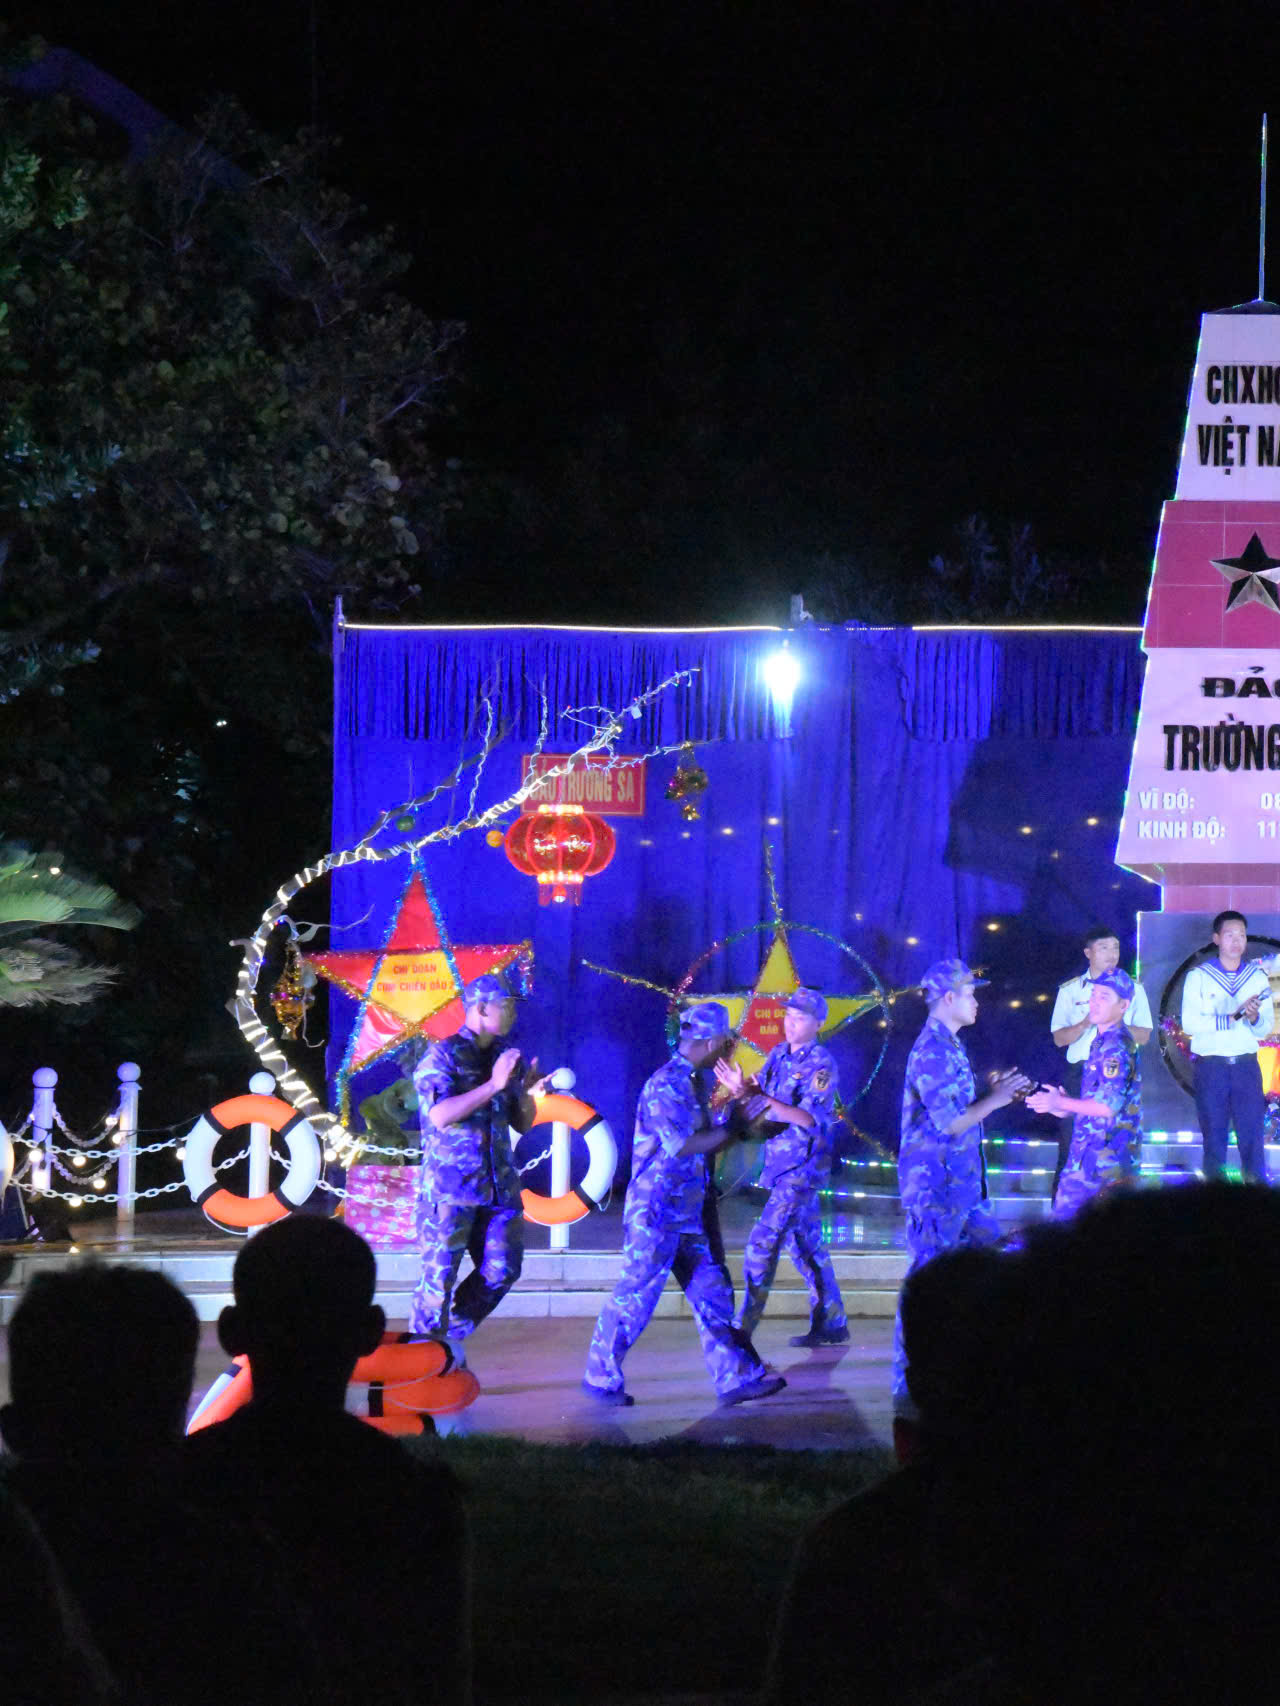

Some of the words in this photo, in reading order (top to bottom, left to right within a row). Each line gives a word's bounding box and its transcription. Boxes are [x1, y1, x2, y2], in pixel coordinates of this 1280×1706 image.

[1197, 416, 1250, 476] VIỆT
[617, 770, 635, 802] SA
[1163, 788, 1195, 814] ĐỘ:
[1138, 820, 1187, 839] KINH
[1191, 817, 1225, 845] ĐỘ:
